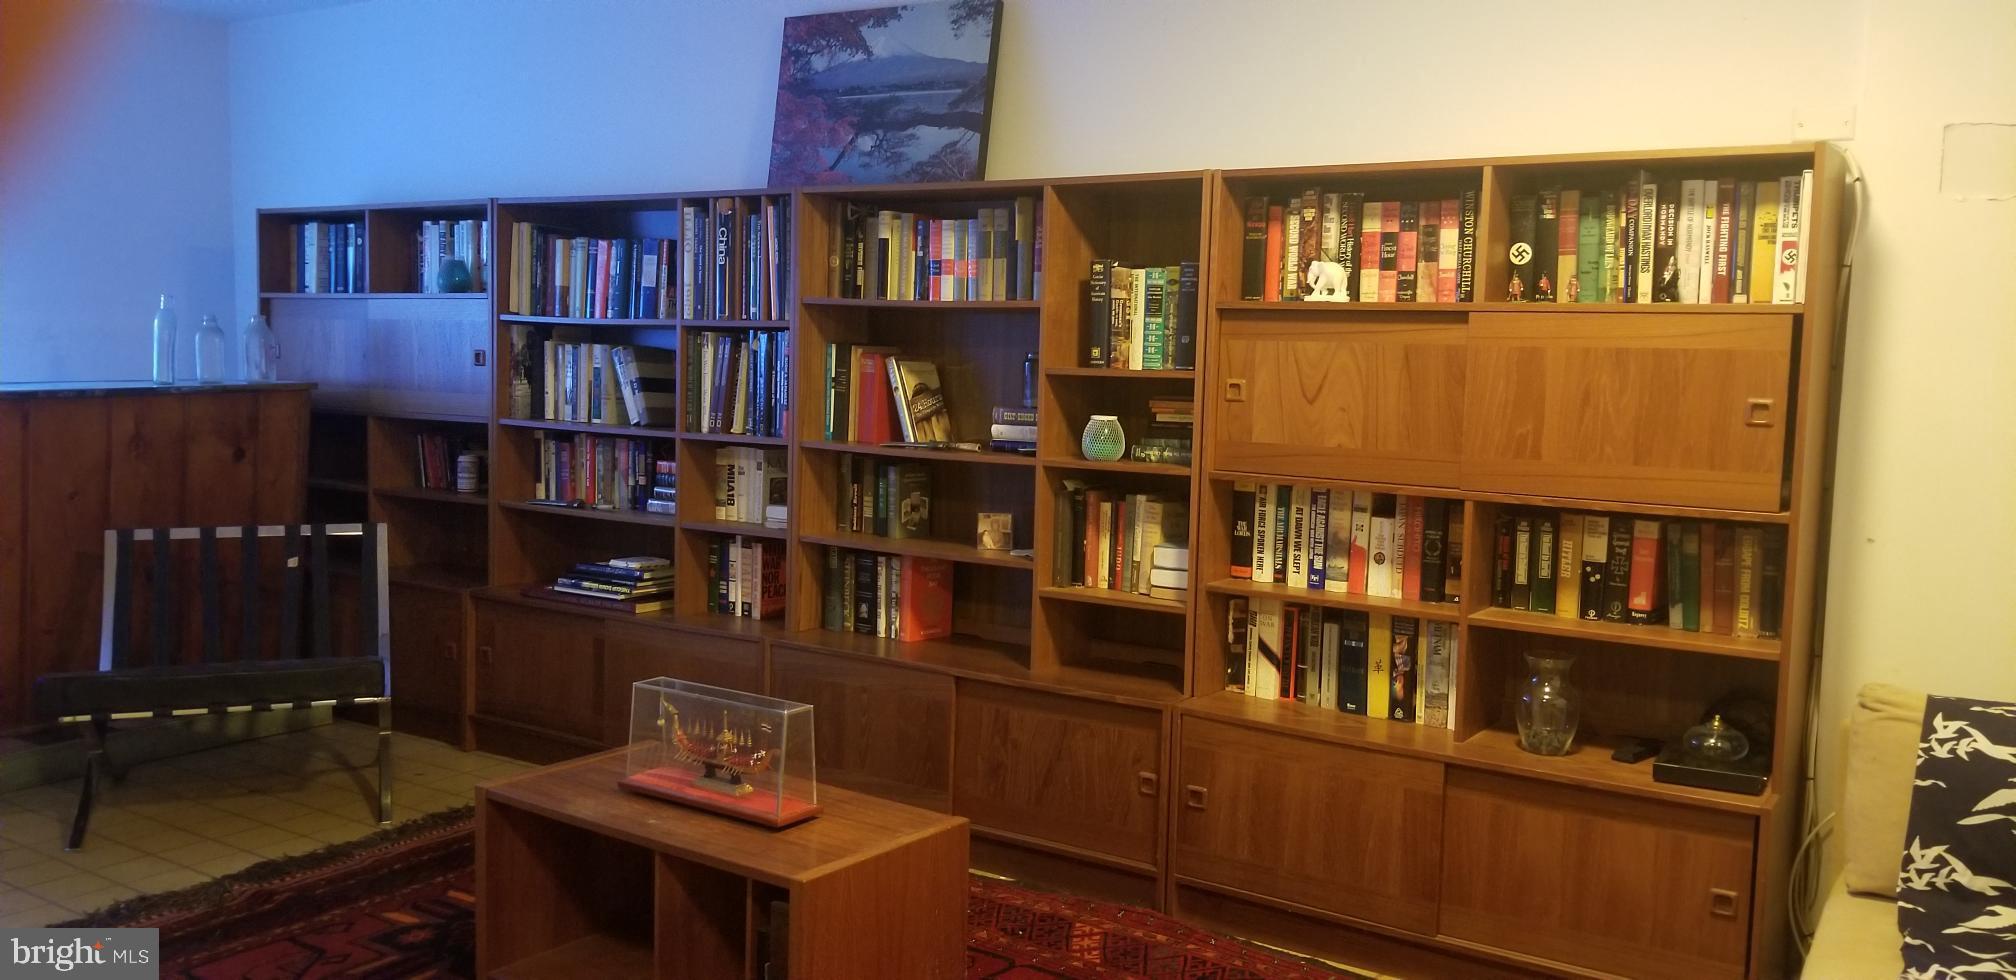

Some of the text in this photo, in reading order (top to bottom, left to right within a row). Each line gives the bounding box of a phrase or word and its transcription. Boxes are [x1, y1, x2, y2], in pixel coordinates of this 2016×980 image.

[1460, 190, 1476, 293] WINSTON CHURCHILL
[1660, 204, 1668, 246] NORMANDY
[1668, 203, 1676, 246] DECISION IN
[1720, 216, 1730, 252] FIGHTING
[718, 227, 729, 265] China
[1286, 214, 1300, 290] SECOND WORLD WAR
[1346, 237, 1355, 259] History
[1641, 241, 1651, 273] HASTINGS
[1718, 253, 1728, 276] FIRST
[726, 463, 736, 507] MILA 18
[1257, 509, 1267, 529] FORCE
[1256, 530, 1266, 555] SPOKEN
[1292, 506, 1304, 576] AT DAWN WE SLEPT
[1560, 539, 1573, 578] HITLER
